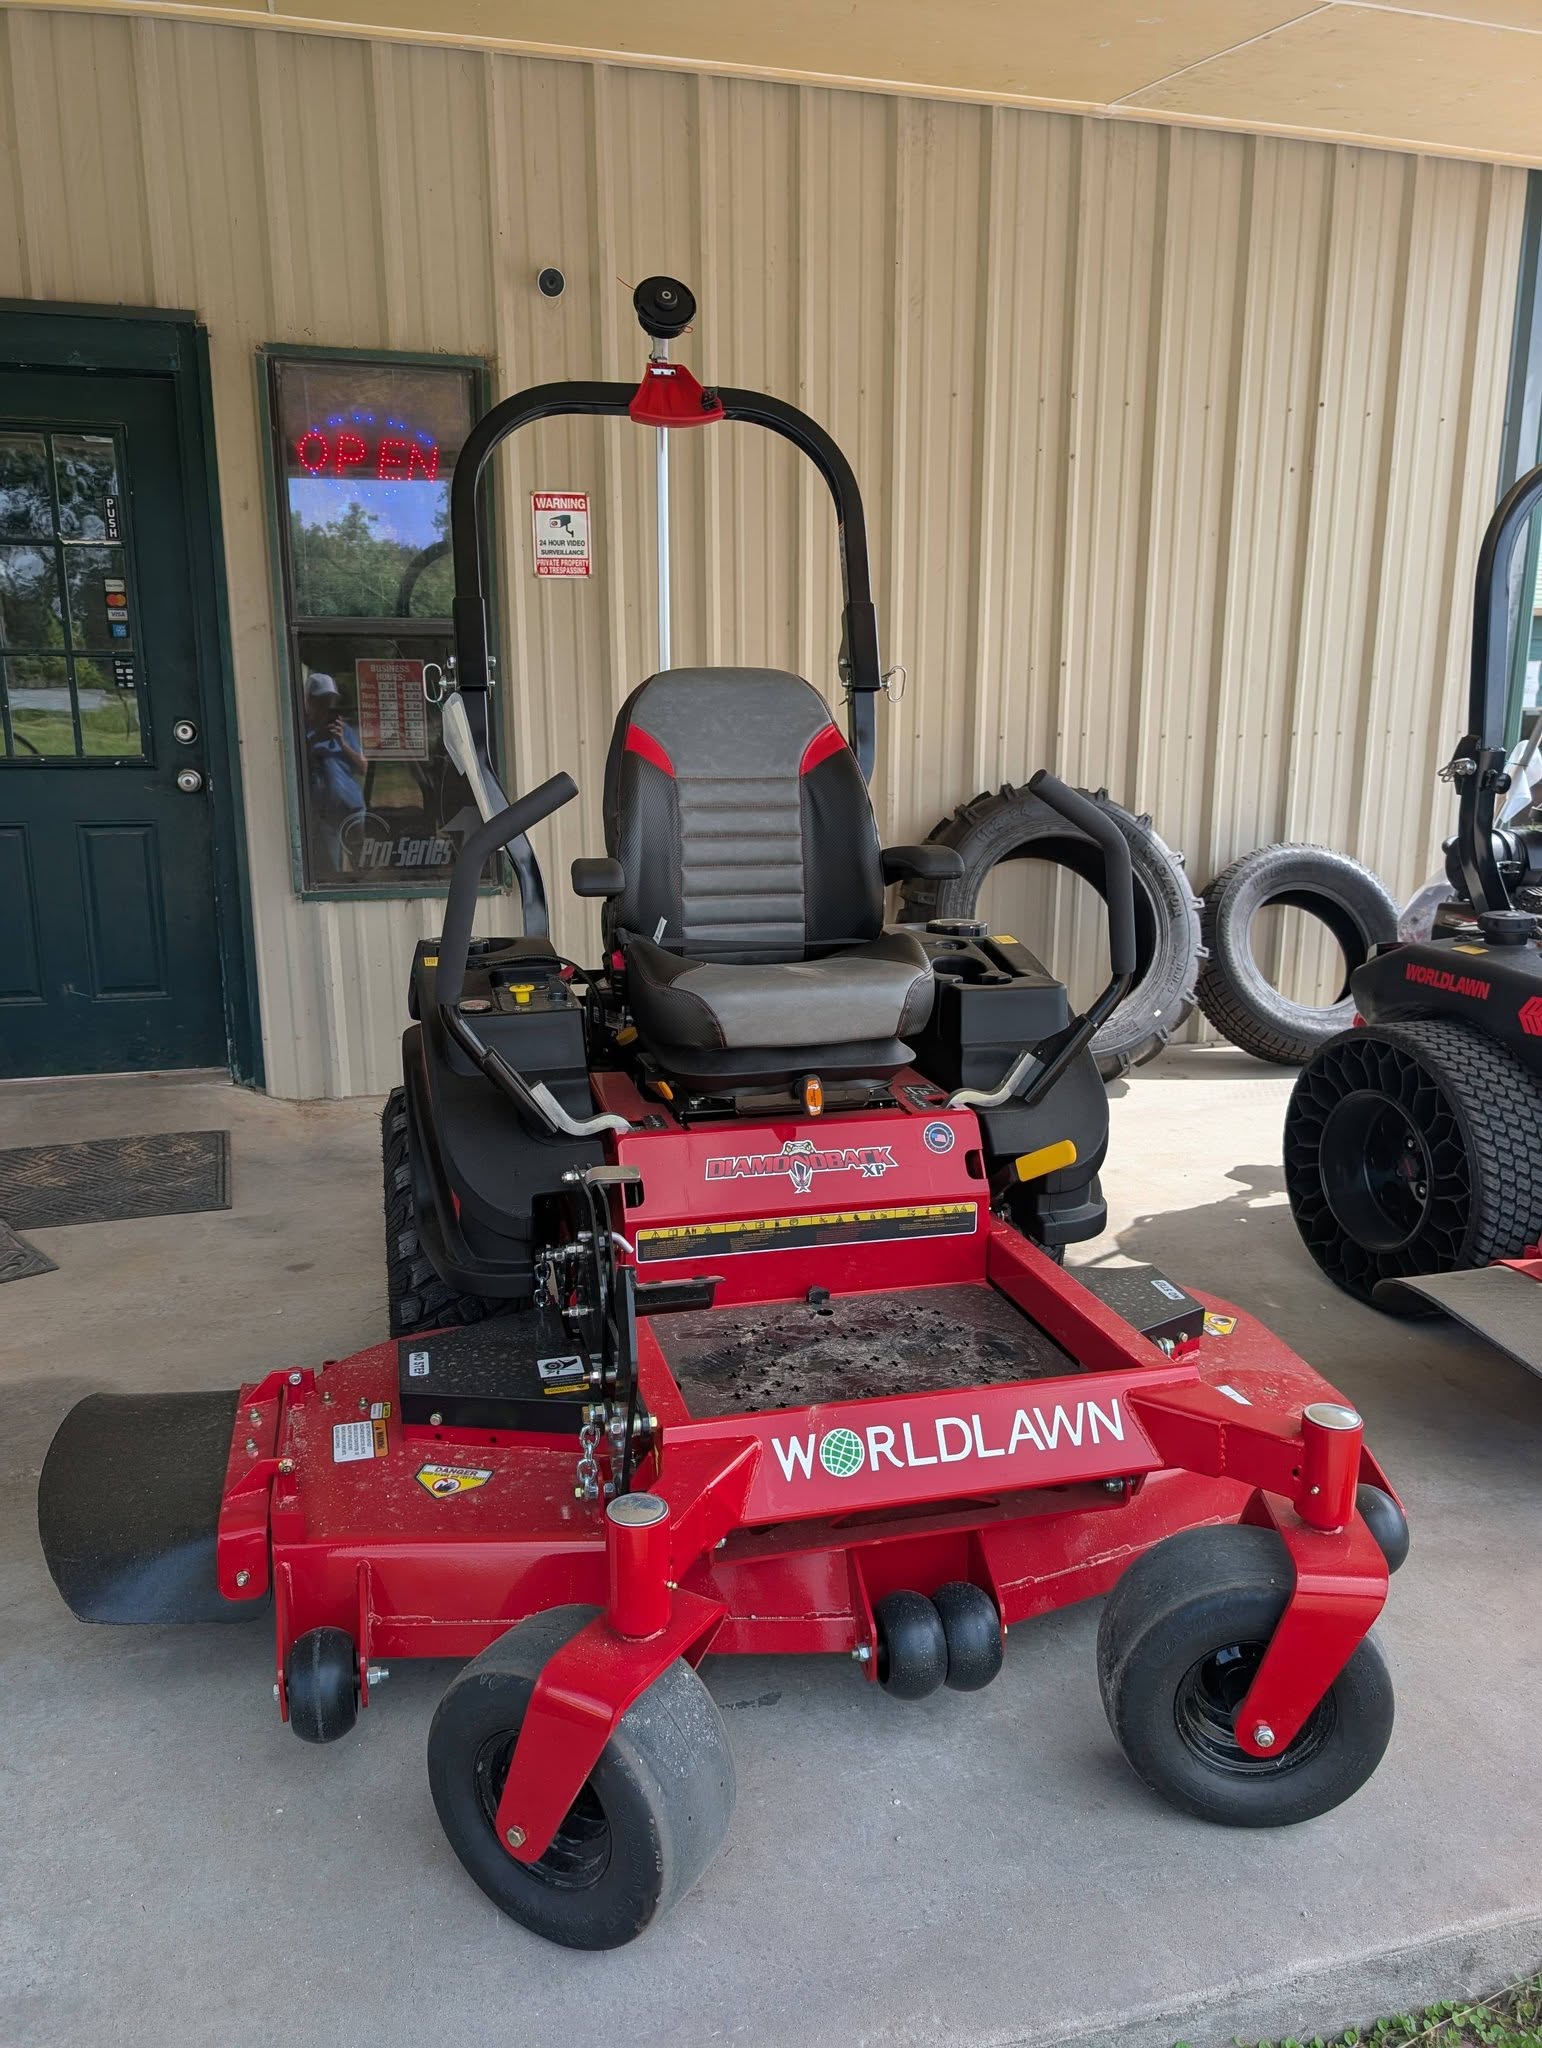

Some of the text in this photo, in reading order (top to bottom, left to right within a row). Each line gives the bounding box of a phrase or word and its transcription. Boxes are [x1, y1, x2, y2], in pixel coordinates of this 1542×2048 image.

[297, 432, 439, 484] OPEN
[535, 497, 586, 510] WARNING
[106, 498, 118, 538] PUSH
[550, 567, 586, 575] TRESPASSING
[561, 559, 588, 567] PROPERTY
[370, 664, 411, 673] BUSINESS
[358, 836, 452, 868] Pro-Series
[1405, 963, 1491, 1000] WORLDLAWN
[863, 1164, 885, 1177] XP
[414, 1352, 424, 1375] NO STEP
[771, 1398, 1124, 1482] WORLDLAWN
[434, 1466, 479, 1476] DANGER
